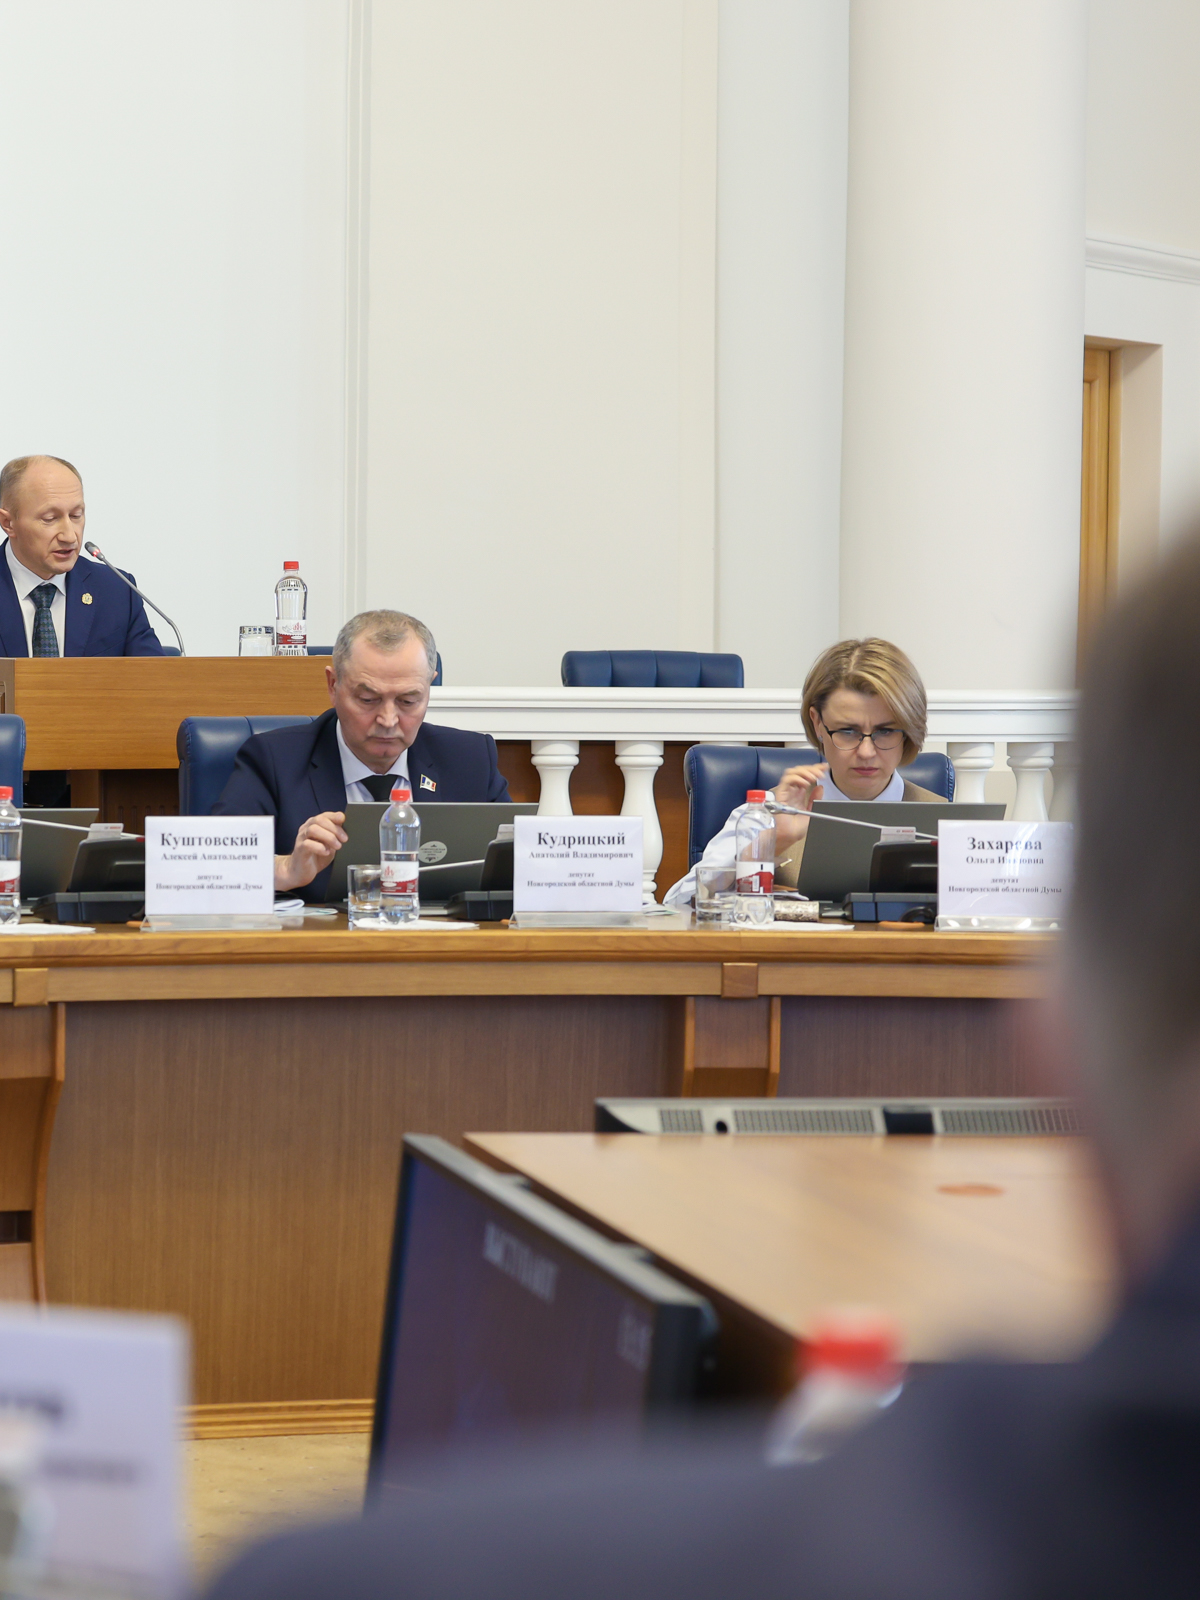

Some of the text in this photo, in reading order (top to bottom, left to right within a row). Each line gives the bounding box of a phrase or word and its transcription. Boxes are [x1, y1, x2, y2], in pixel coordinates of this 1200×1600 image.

[160, 832, 259, 850] Куштовский
[537, 832, 626, 849] Кудрицкий
[161, 852, 258, 861] Алексей Анатольевич
[529, 851, 634, 860] Анатолий Владимирович
[966, 856, 995, 864] Ольга
[156, 883, 205, 891] Новгородской
[242, 883, 263, 891] Думы
[527, 880, 576, 888] Новгородской
[948, 885, 1062, 894] Новгородской областной Думы
